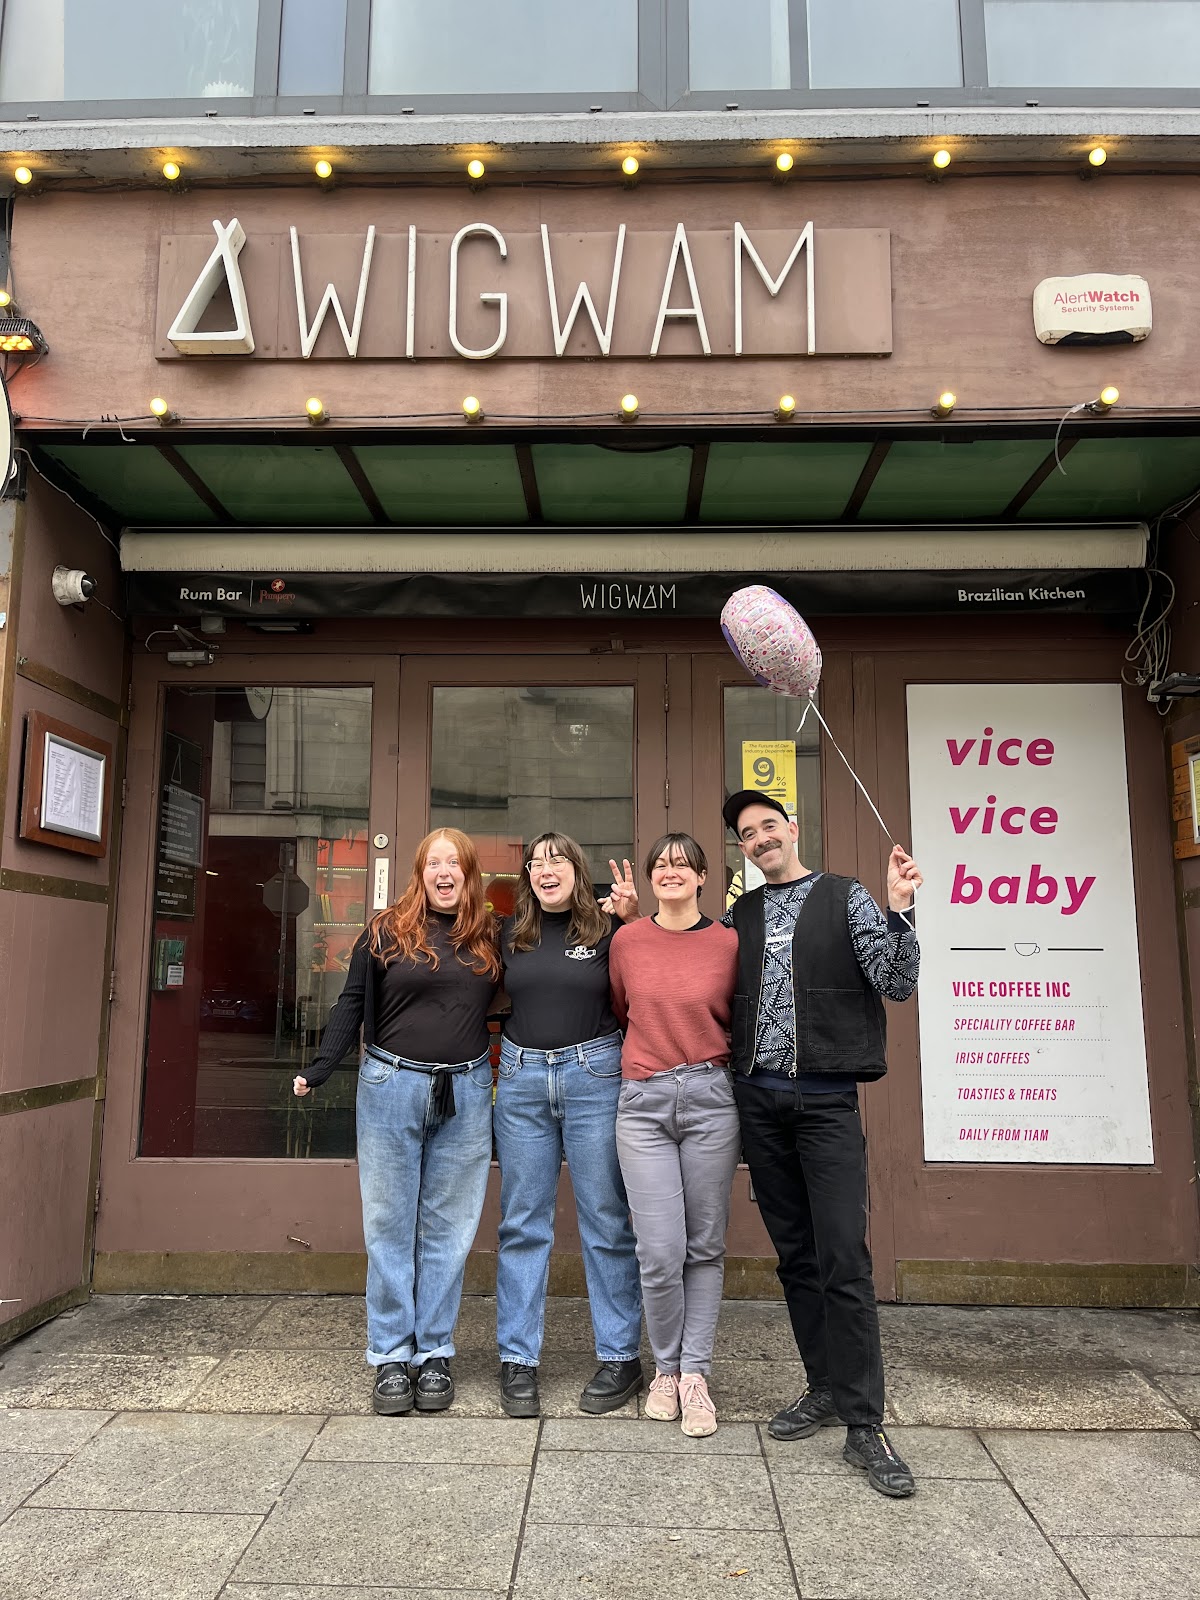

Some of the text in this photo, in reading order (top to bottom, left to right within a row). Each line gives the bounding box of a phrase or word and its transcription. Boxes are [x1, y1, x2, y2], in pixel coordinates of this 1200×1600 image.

[290, 221, 816, 358] WIGWAM
[1053, 289, 1140, 304] AlertWatch
[1061, 304, 1134, 313] Security Systems
[179, 587, 243, 601] Rum Bar
[579, 583, 676, 610] WIGWAM
[957, 587, 1086, 602] Brazilian Kitchen
[946, 727, 1055, 767] vice
[948, 794, 1060, 836] vice
[949, 863, 1097, 917] baby
[952, 981, 1071, 998] VICE COFFEE INC
[953, 1018, 1076, 1031] SPECIALITY COFFEE BAR
[955, 1051, 1031, 1064] IRISH COFFEES
[957, 1087, 1058, 1101] TOASTIES & TREATS
[959, 1128, 1049, 1142] DAILY FROM 11AM
